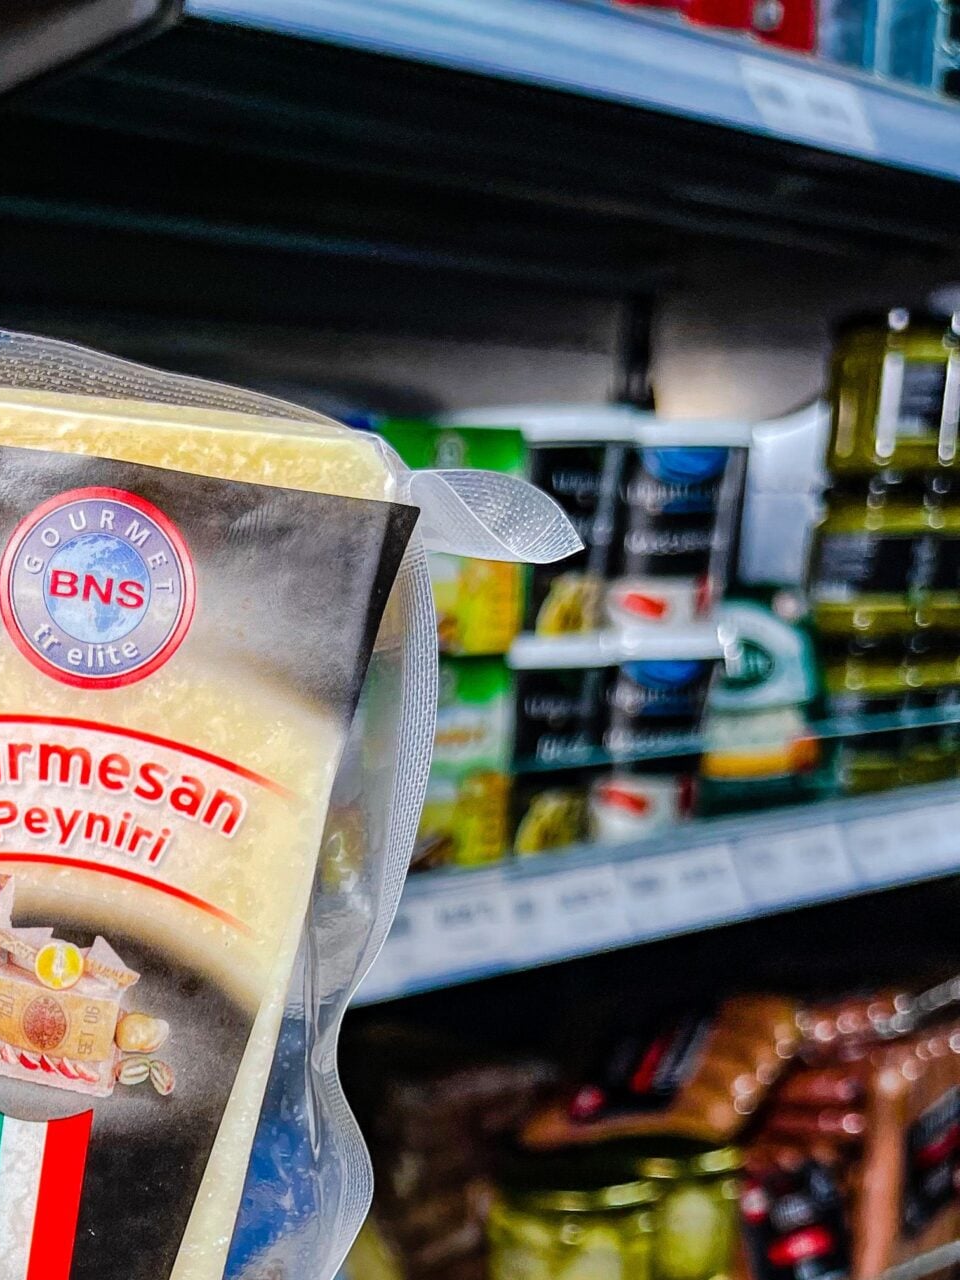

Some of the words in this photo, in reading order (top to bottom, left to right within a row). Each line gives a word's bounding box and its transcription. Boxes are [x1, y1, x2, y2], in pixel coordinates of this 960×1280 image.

[24, 509, 175, 595] GOURMET
[48, 568, 146, 611] BNS
[34, 622, 63, 651] tr
[67, 641, 139, 668] elite
